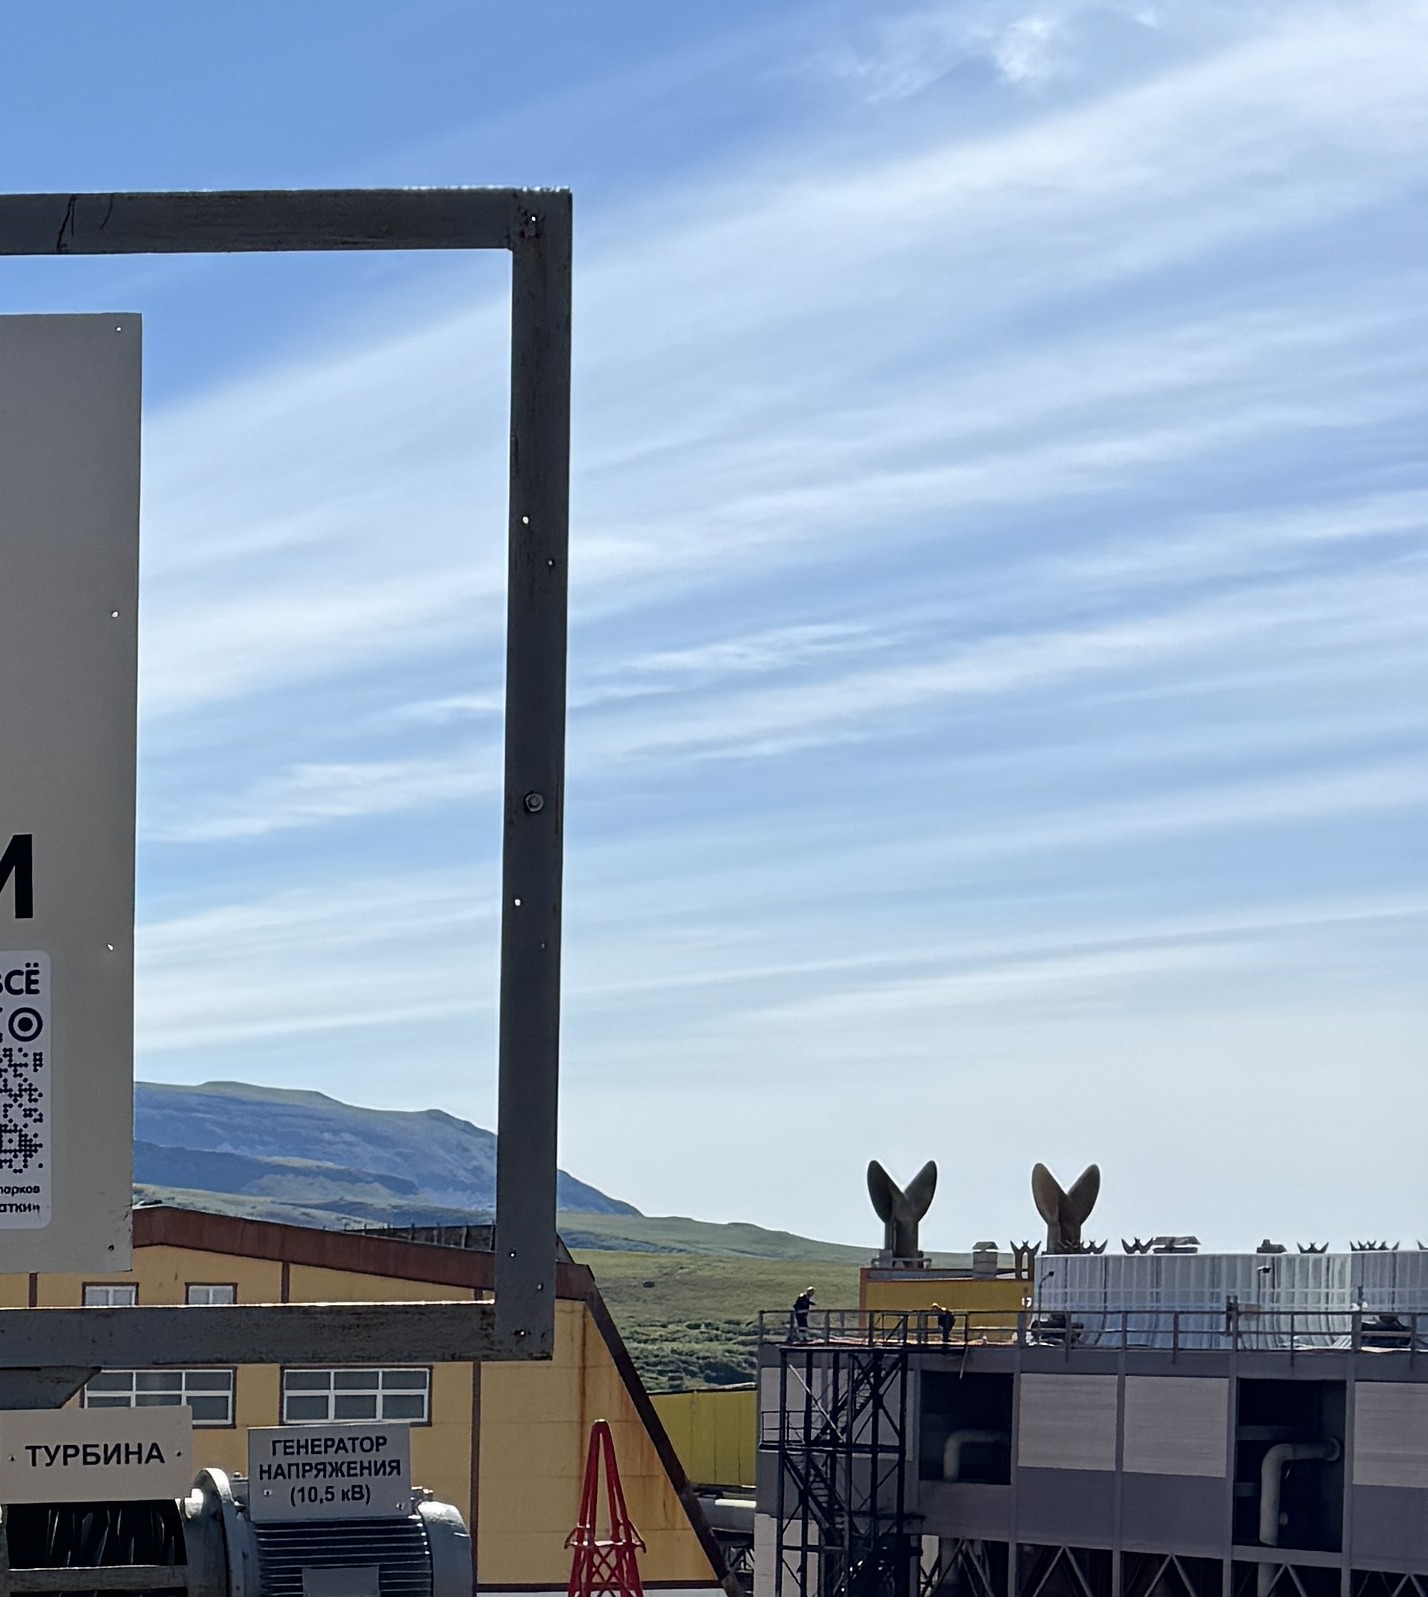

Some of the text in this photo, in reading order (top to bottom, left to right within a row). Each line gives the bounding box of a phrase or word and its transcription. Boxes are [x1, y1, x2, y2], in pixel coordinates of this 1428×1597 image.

[24, 1441, 166, 1468] ТУРБИНА
[269, 1434, 389, 1457] ГЕНЕРАТОР
[257, 1459, 402, 1482] НАПРЯЖЕНИЯ
[289, 1484, 371, 1508] (10,5 кВ)
